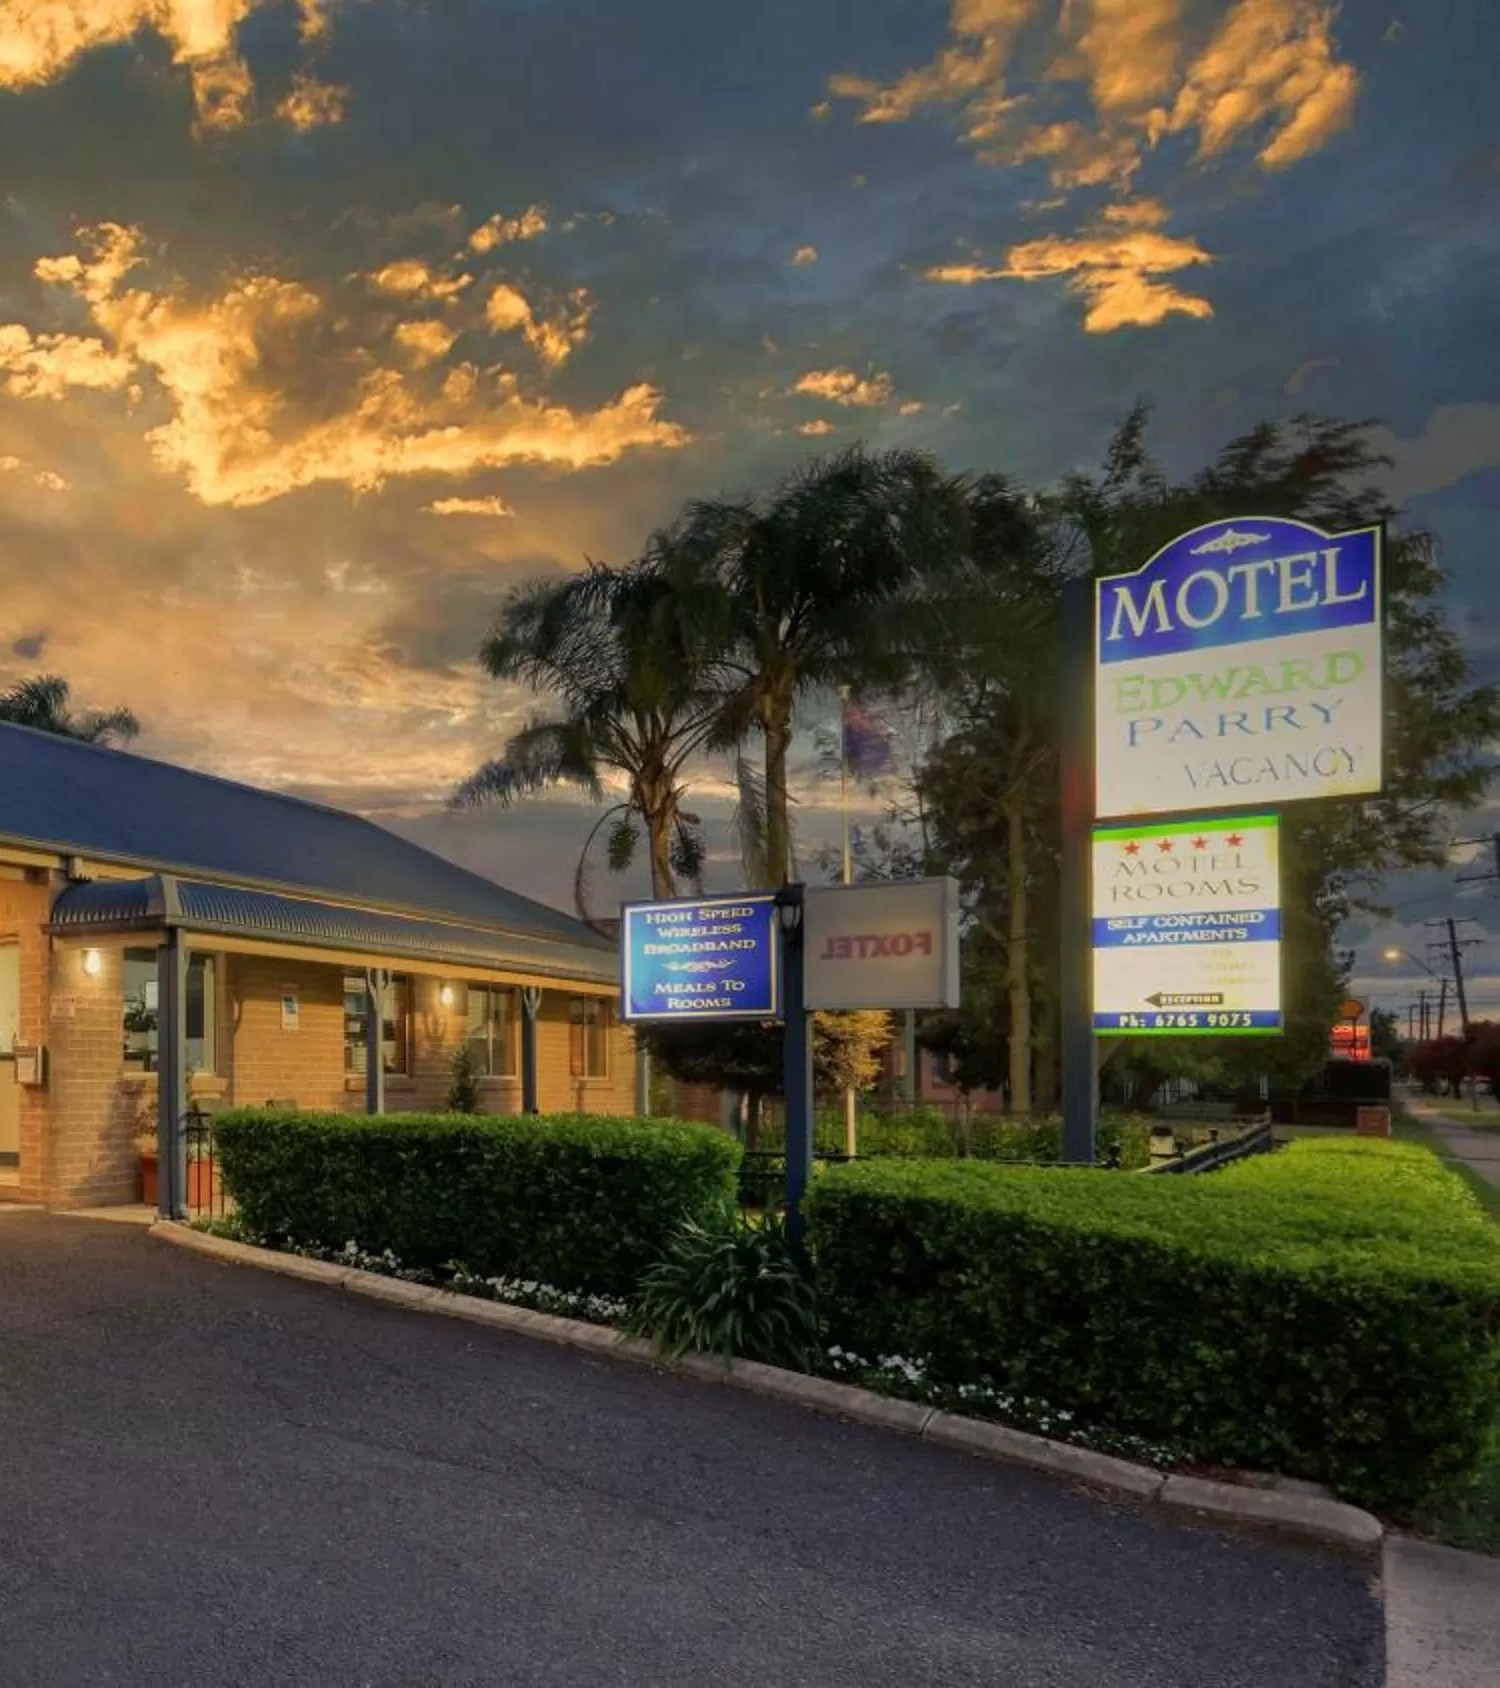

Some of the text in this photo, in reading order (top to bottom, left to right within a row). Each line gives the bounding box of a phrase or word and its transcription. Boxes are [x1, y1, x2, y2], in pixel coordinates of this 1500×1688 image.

[1106, 548, 1367, 641] MOTEL
[1112, 649, 1365, 713] EDWARD
[1127, 698, 1345, 748] PARRY
[1183, 746, 1364, 789] VACANCY
[1113, 852, 1257, 878] MOTEL
[1111, 877, 1261, 903] ROOMS
[644, 907, 755, 925] HIGH SPEED
[1107, 911, 1266, 931] SELF CONTAINED
[656, 923, 743, 938] WIRELESS
[1123, 927, 1248, 945] APARTMENTS
[643, 939, 756, 955] BROADBAND
[653, 982, 717, 995] MEALS
[667, 998, 732, 1009] ROOMS
[1155, 1012, 1198, 1027] 6765
[1207, 1012, 1252, 1027] 9075
